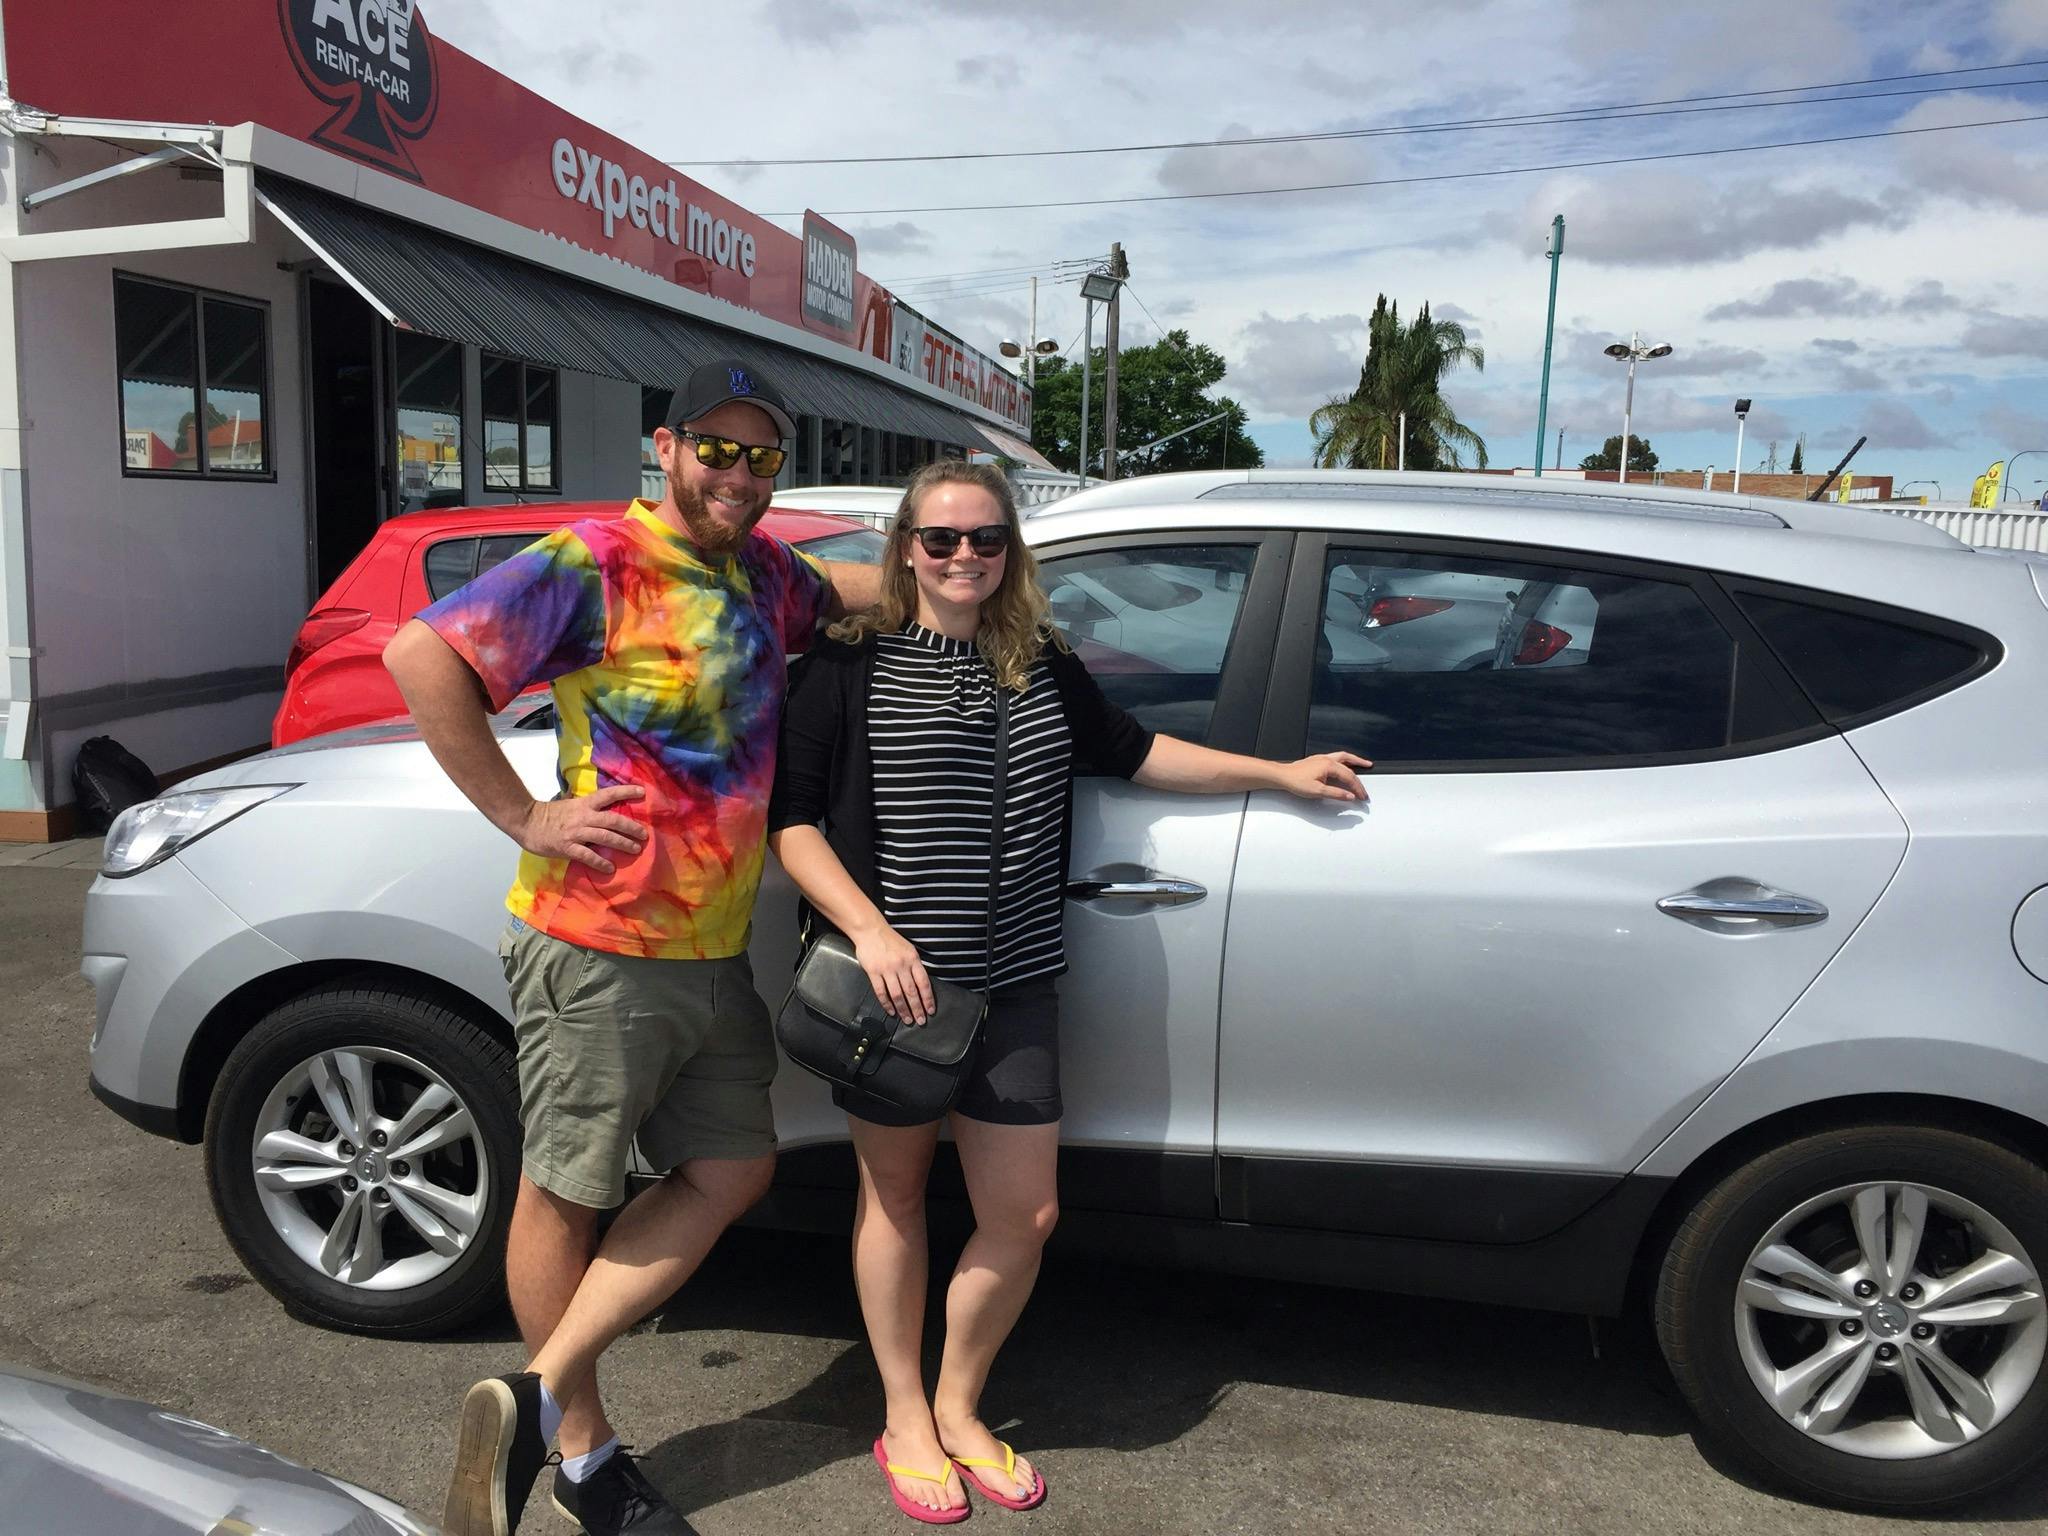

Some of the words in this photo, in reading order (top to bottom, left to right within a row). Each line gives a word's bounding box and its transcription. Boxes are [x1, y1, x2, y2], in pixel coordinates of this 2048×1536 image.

[312, 0, 411, 71] ACE
[315, 37, 411, 105] RENT-A-CAR
[552, 138, 681, 246] expect
[686, 203, 756, 279] more
[808, 234, 853, 300] HADDEN
[806, 283, 827, 313] MOTOR
[827, 292, 853, 322] COMPANY
